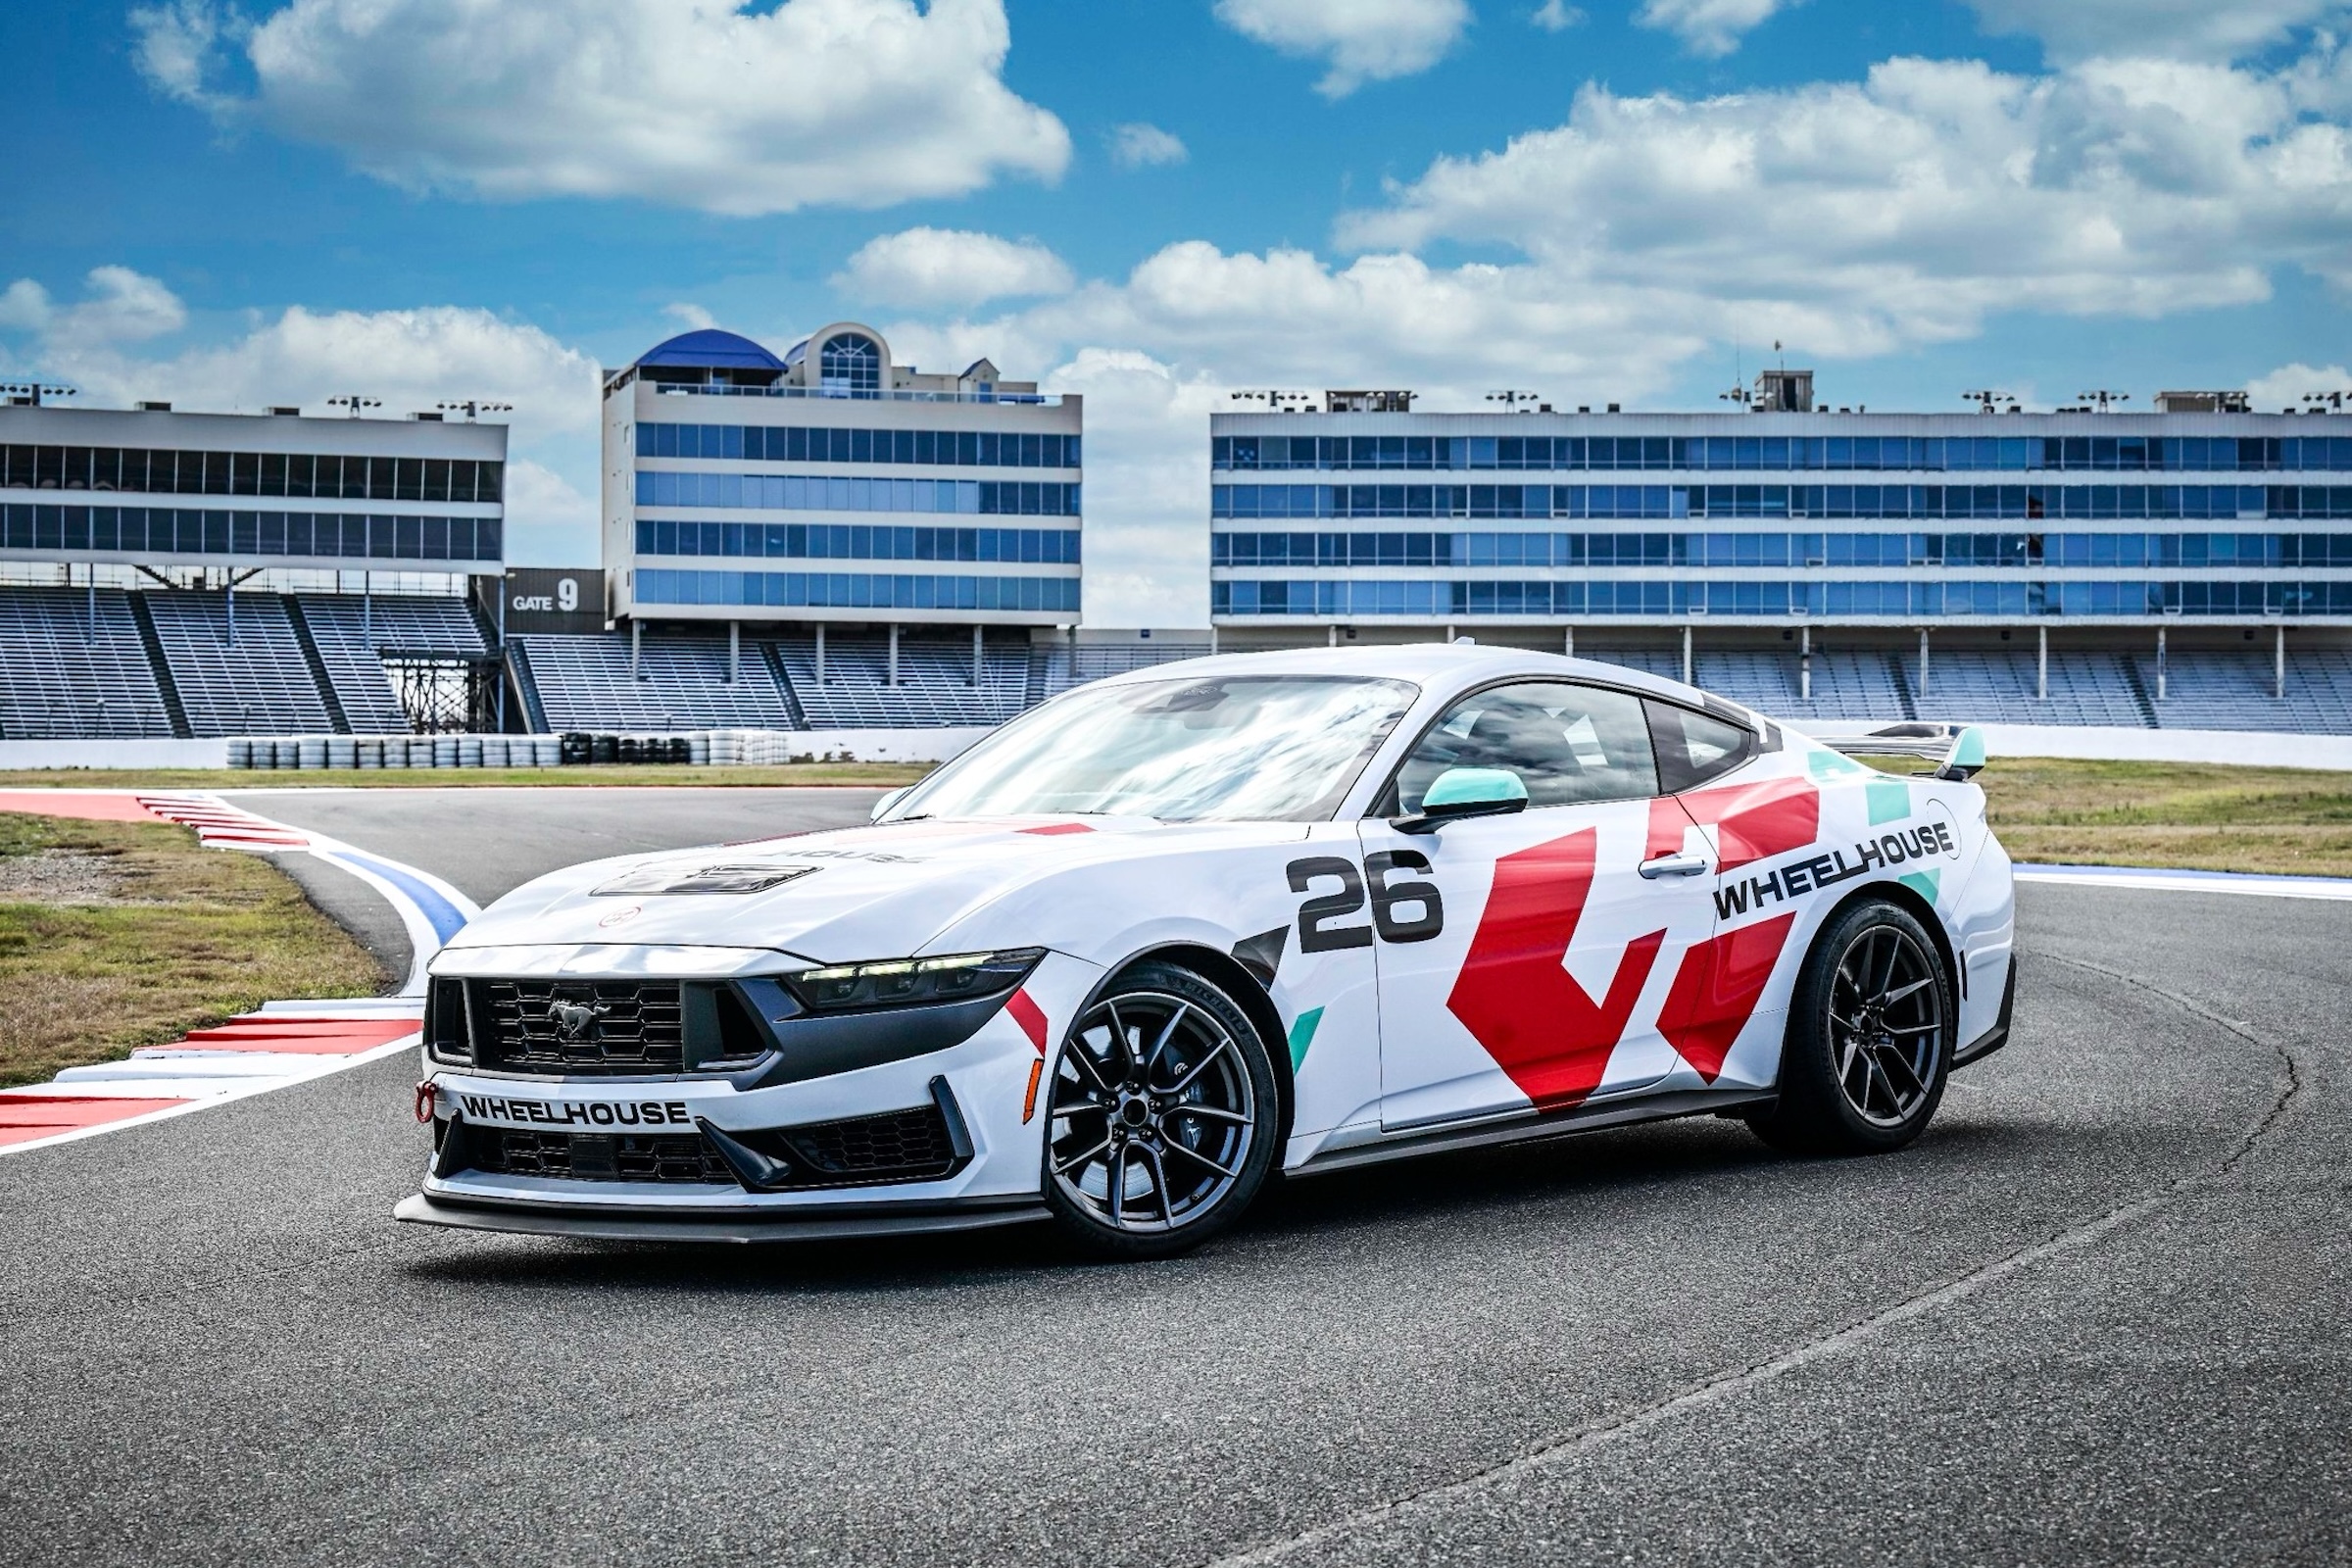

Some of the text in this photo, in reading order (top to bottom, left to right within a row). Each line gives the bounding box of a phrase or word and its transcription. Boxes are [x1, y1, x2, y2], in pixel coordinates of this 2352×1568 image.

[513, 577, 578, 612] GATE 9
[1286, 850, 1444, 954] 26
[1712, 821, 1954, 921] WHEELHOUSE
[460, 1095, 691, 1125] WHEELHOUSE
